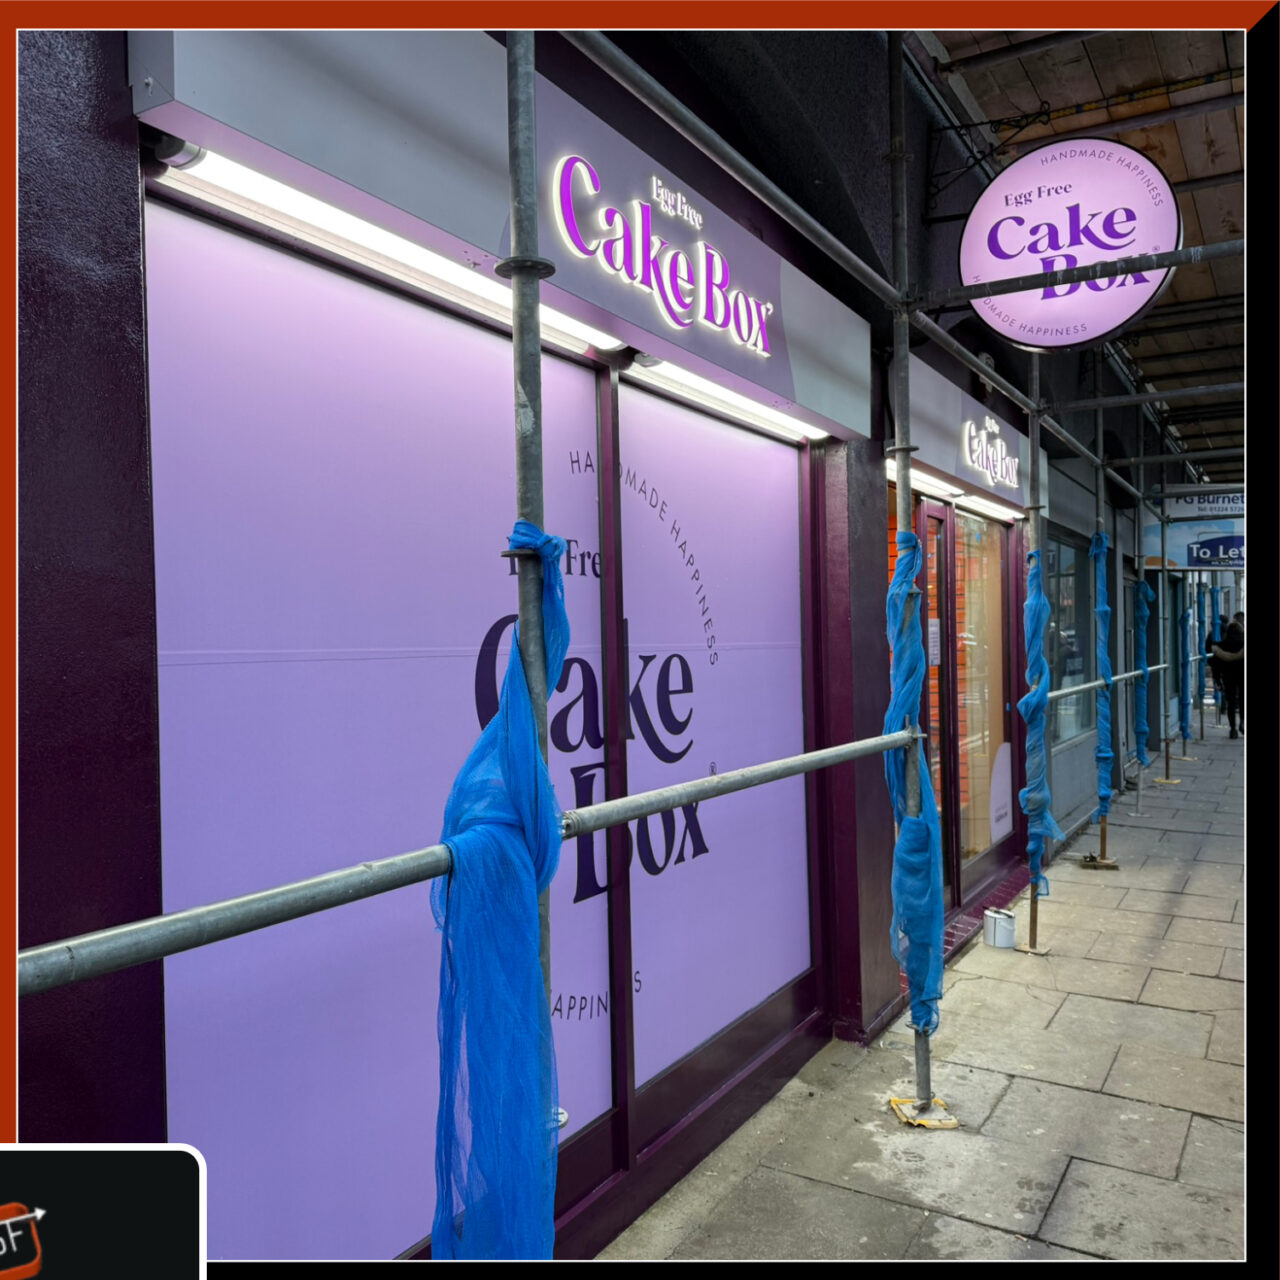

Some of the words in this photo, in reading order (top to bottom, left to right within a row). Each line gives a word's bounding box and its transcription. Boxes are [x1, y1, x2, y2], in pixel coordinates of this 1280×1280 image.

[1003, 192, 1033, 208] Egg
[1037, 182, 1073, 199] Free
[1041, 149, 1115, 166] HANDMADE
[1115, 155, 1164, 207] HAPPINESS
[986, 202, 1137, 260] Cake
[553, 154, 695, 330] Cake
[697, 240, 771, 358] Box
[1018, 322, 1088, 337] HAPPINESS
[565, 539, 602, 579] Fre
[1189, 544, 1211, 559] To
[670, 519, 719, 666] HAPPINESS
